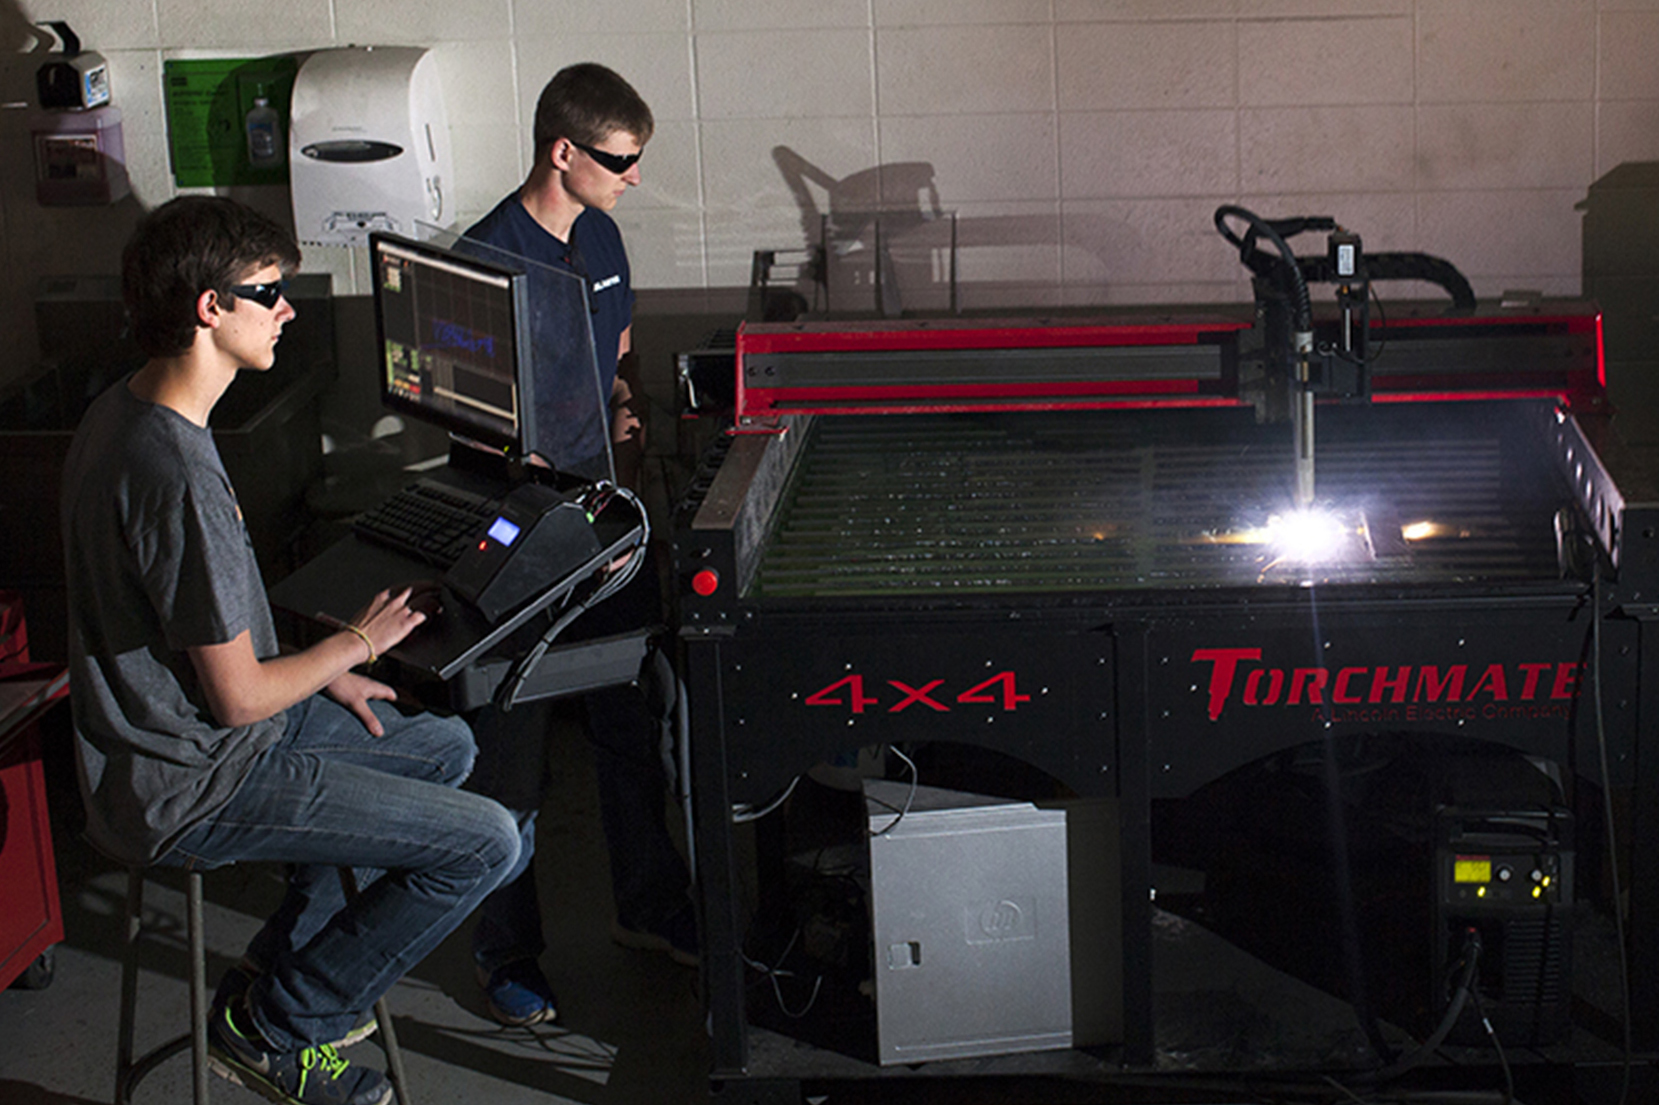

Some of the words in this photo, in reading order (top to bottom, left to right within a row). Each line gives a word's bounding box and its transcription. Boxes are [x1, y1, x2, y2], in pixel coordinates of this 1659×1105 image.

[1191, 647, 1588, 721] TORCHMATE
[1331, 706, 1400, 722] Lincoln
[1405, 704, 1476, 721] Electric
[1482, 702, 1572, 721] Company
